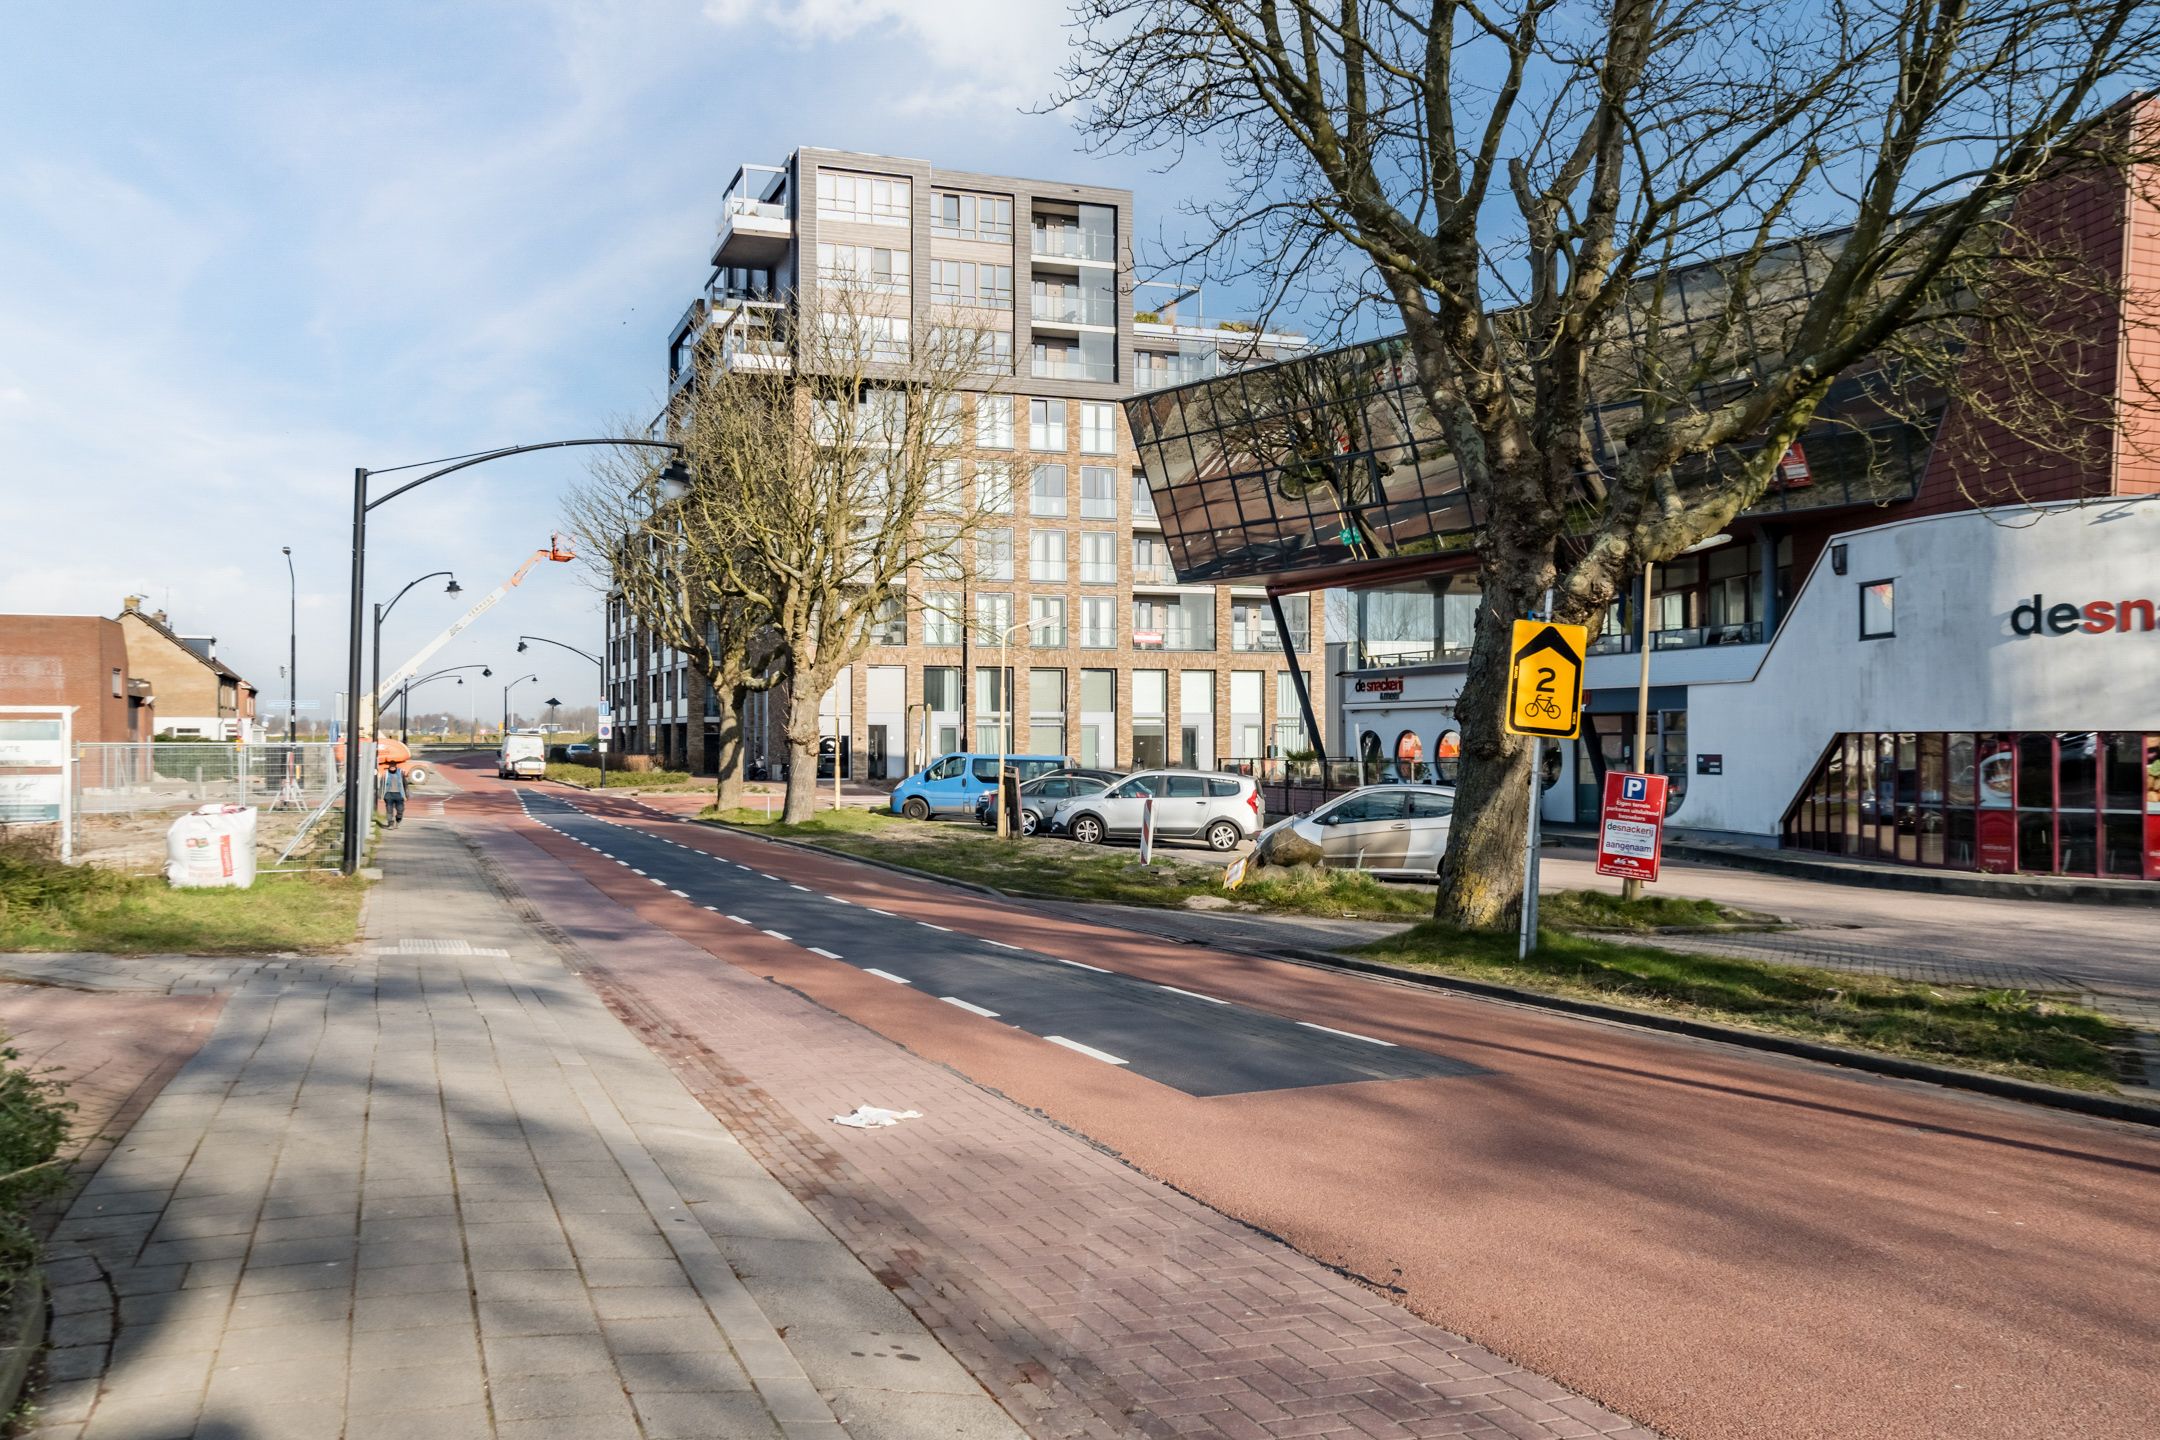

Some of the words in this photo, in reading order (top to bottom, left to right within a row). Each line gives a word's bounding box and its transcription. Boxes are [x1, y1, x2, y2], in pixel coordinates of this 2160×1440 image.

[2011, 593, 2160, 636] desn
[1355, 679, 1366, 692] de
[1367, 676, 1403, 693] snackerij
[1535, 667, 1556, 693] 2
[1627, 779, 1642, 797] P
[1607, 822, 1654, 837] desnackerij
[1605, 841, 1652, 853] aangenaam
